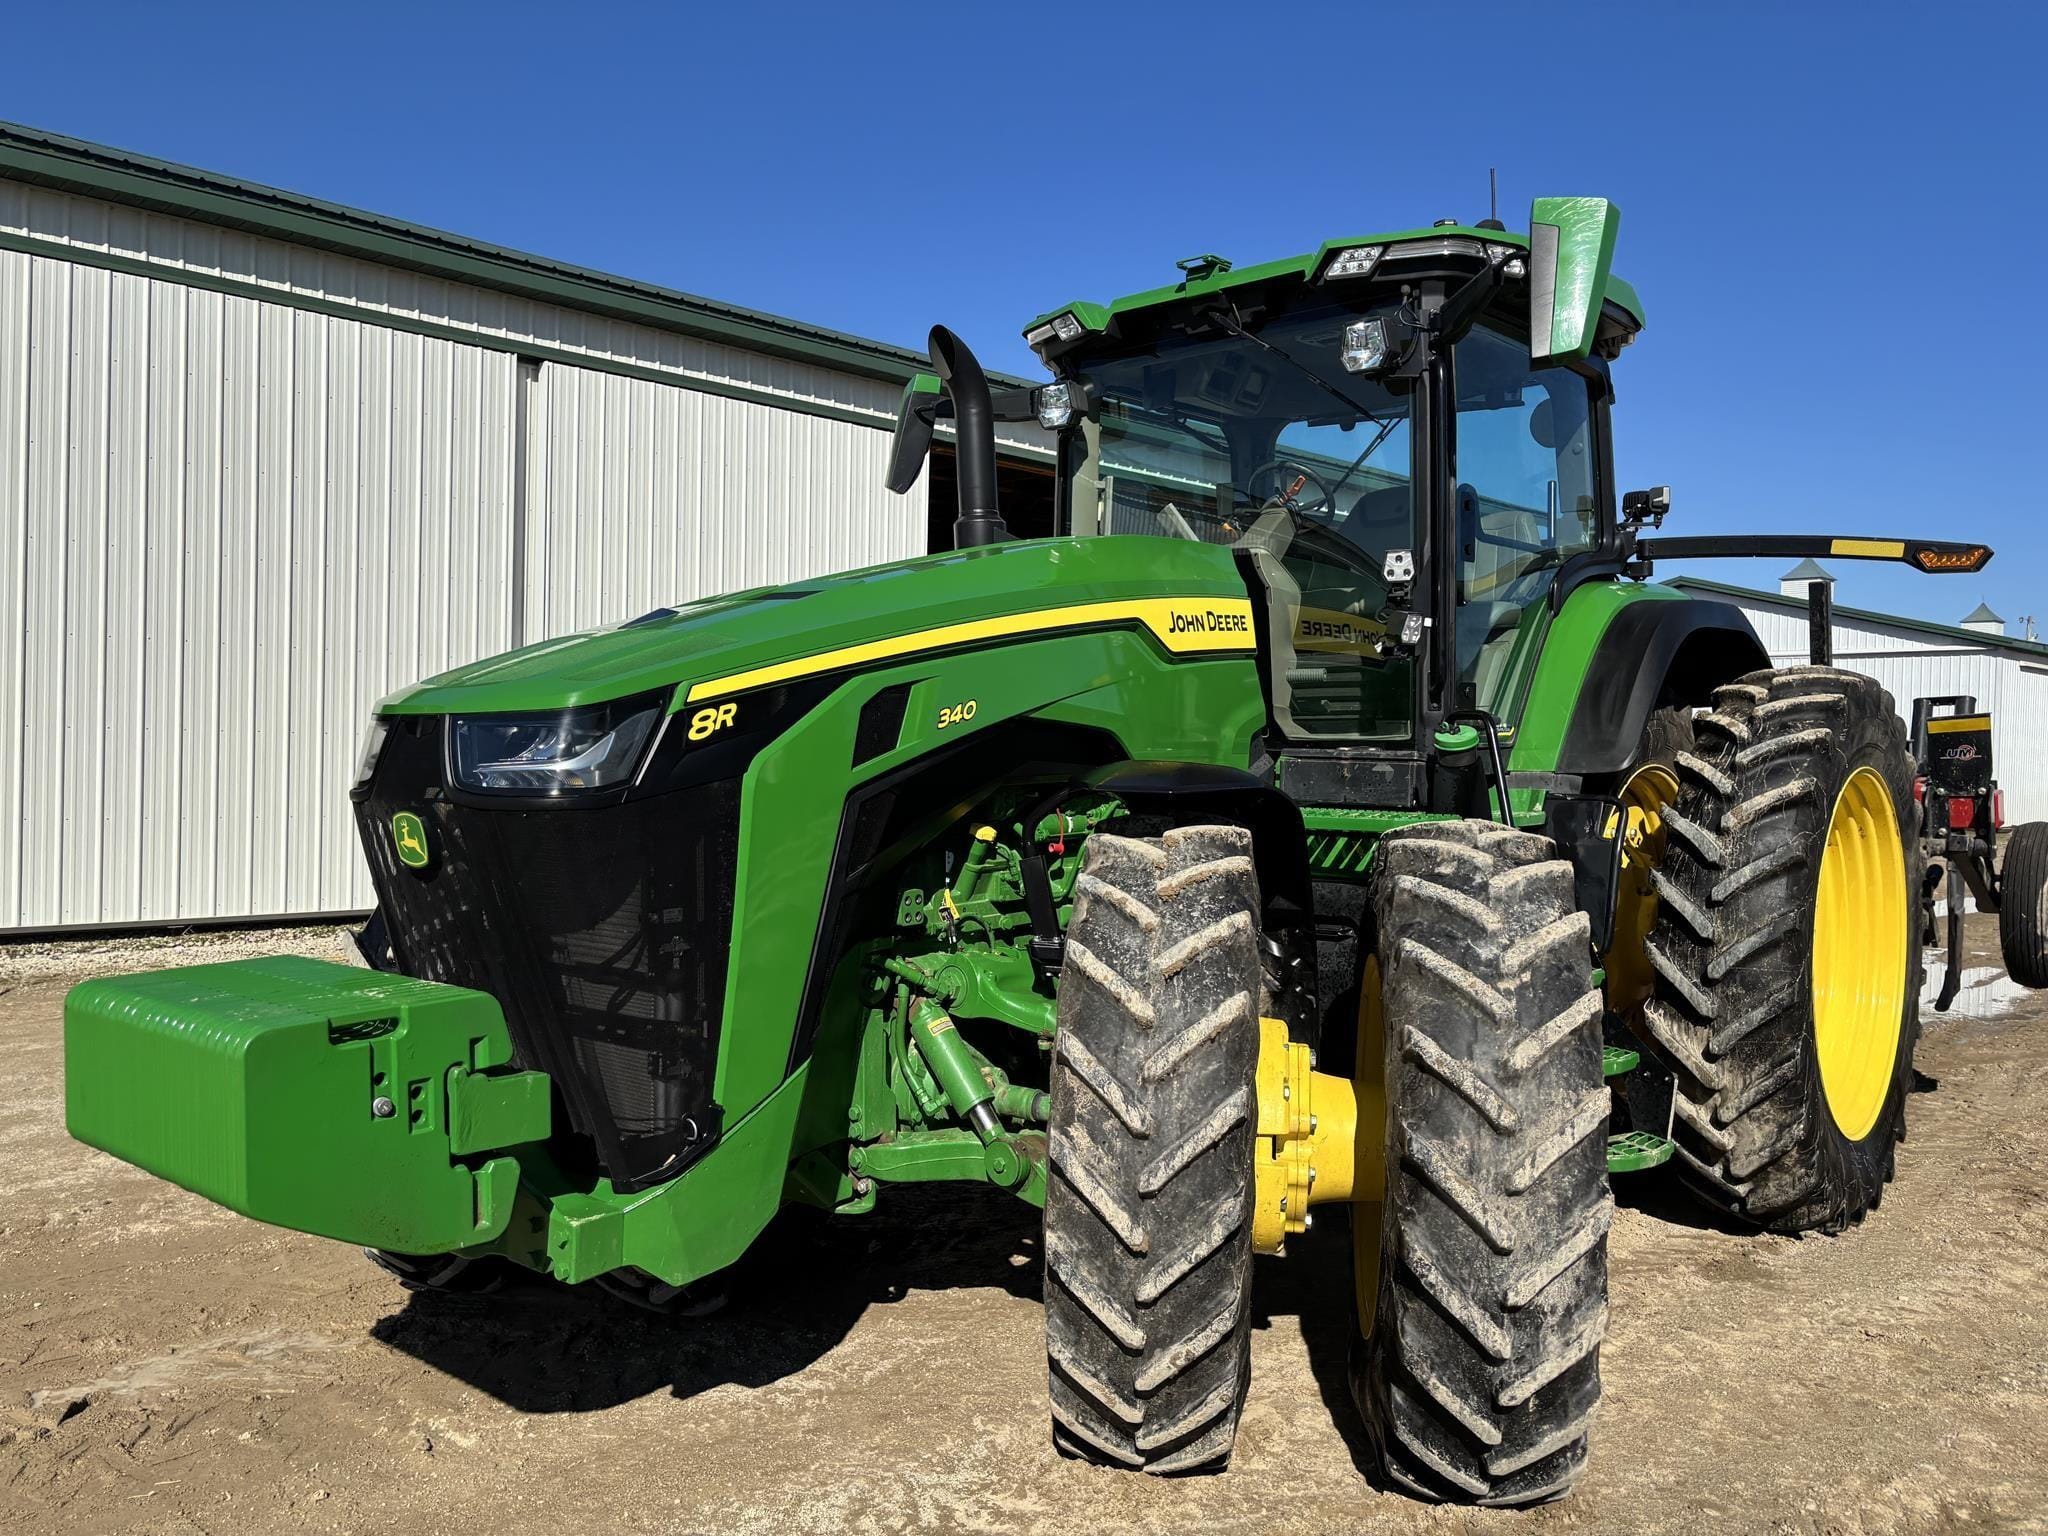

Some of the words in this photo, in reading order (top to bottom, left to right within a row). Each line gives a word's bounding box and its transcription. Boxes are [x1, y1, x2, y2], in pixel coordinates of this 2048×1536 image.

[1169, 610, 1205, 633] JOHN
[1206, 610, 1248, 632] DEERE
[688, 703, 737, 741] 8R
[937, 699, 977, 729] 340
